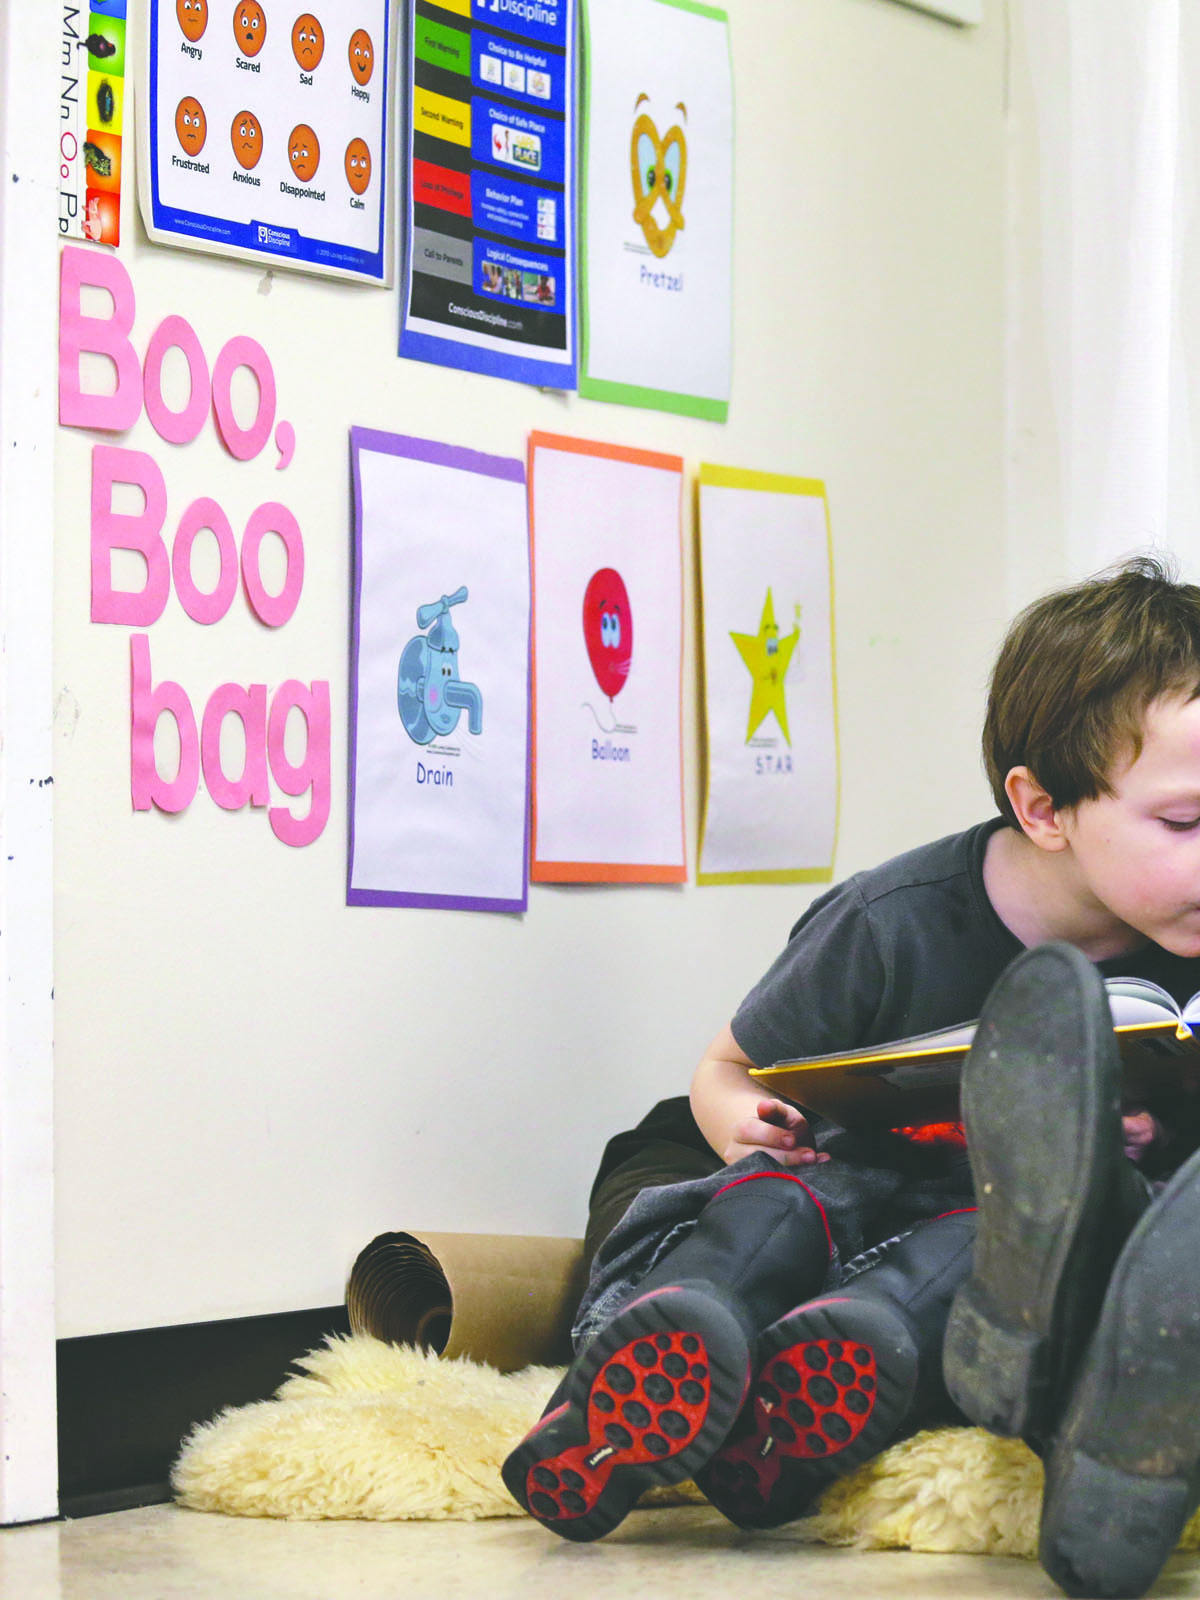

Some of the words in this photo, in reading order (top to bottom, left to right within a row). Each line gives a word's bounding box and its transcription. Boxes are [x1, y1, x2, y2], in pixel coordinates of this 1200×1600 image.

[500, 0, 557, 26] Discipline
[181, 42, 203, 60] Angry
[235, 57, 261, 73] Scared
[299, 73, 313, 86] Sad
[351, 85, 370, 104] Happy
[488, 108, 508, 122] Choice
[172, 155, 210, 174] Frustrated
[233, 171, 261, 187] Anxious
[280, 182, 326, 201] Disappointed
[349, 197, 365, 210] Calm
[268, 228, 290, 240] Conscious
[268, 235, 290, 247] Discipline
[640, 264, 683, 292] Pretzel
[59, 245, 296, 471] Boo,
[90, 444, 304, 627] Boo
[130, 633, 331, 847] bag
[591, 738, 630, 762] Balloon
[416, 761, 453, 786] Drain
